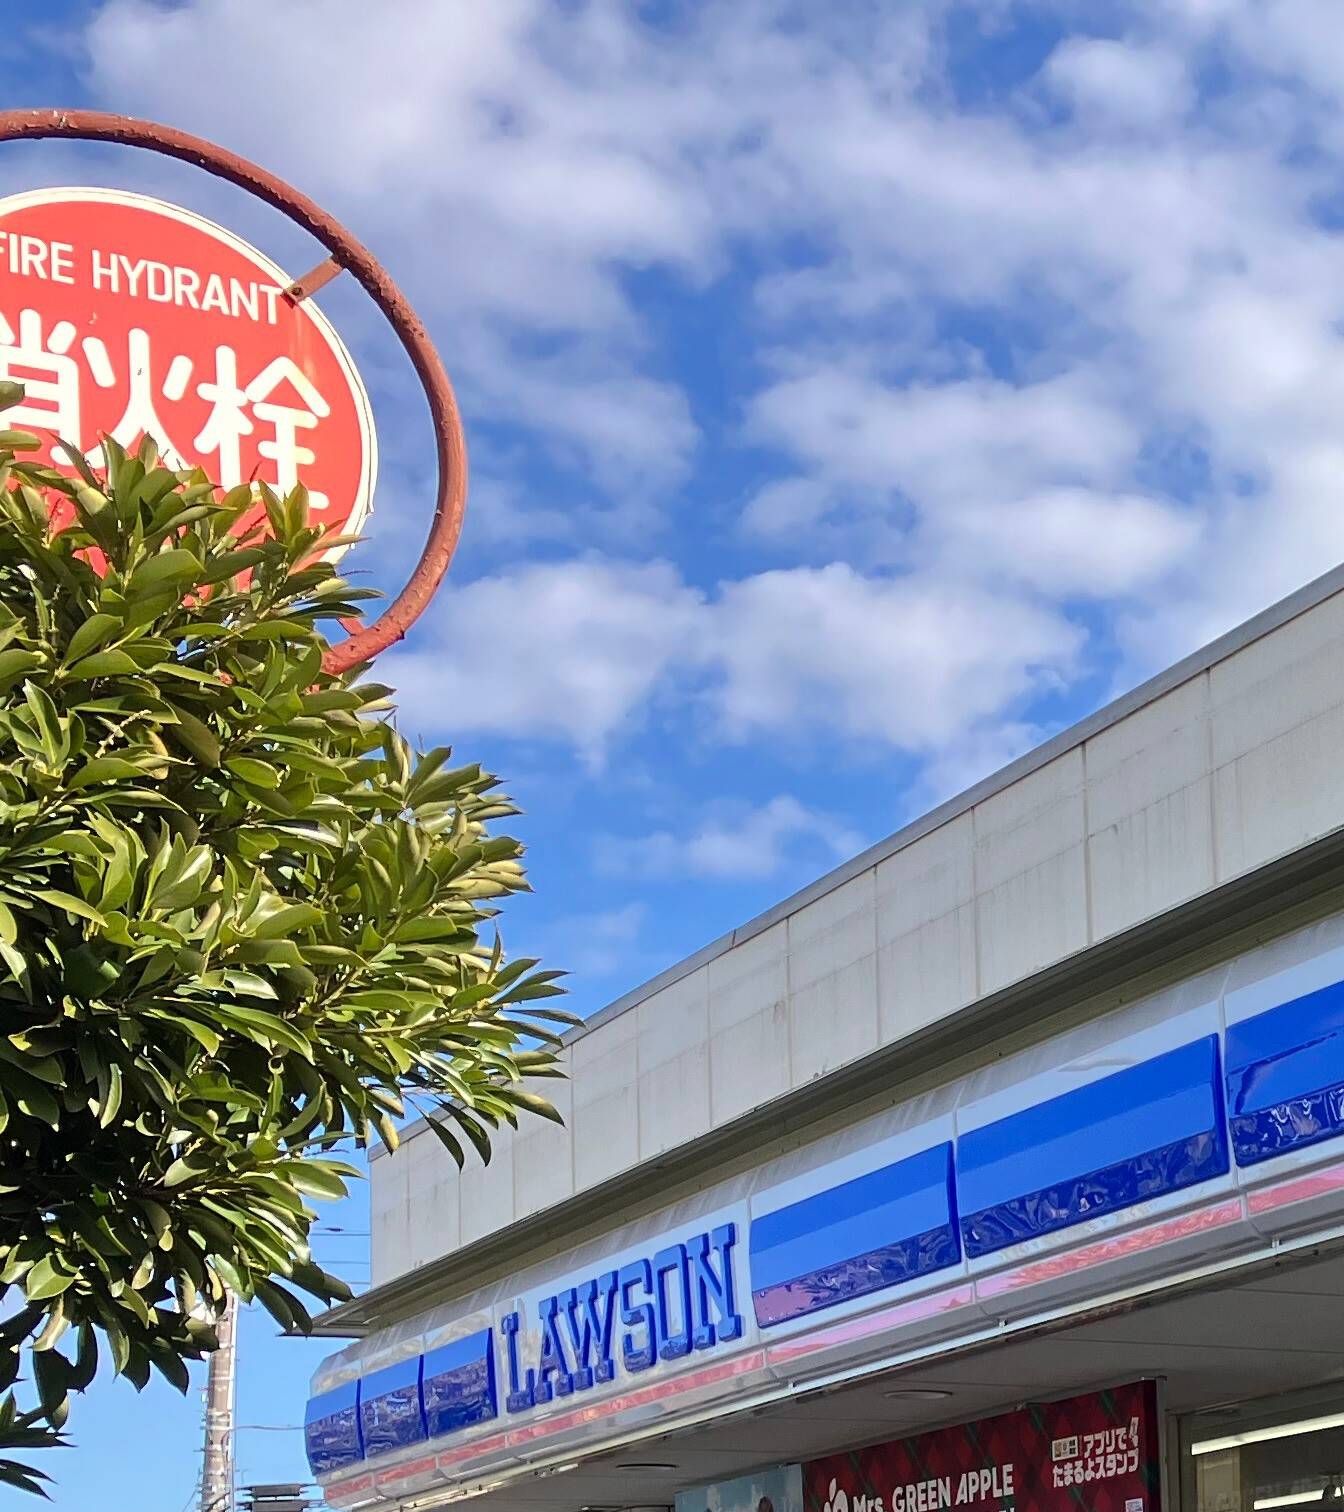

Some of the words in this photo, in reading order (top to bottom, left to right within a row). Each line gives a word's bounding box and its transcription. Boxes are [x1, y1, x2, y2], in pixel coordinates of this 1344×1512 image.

[92, 249, 283, 325] HYDRANT
[501, 1222, 742, 1414] LAWSON
[1083, 1426, 1128, 1459] アプリで
[955, 1463, 1014, 1505] APPLE
[1052, 1448, 1140, 1489] たまるよスタンプ
